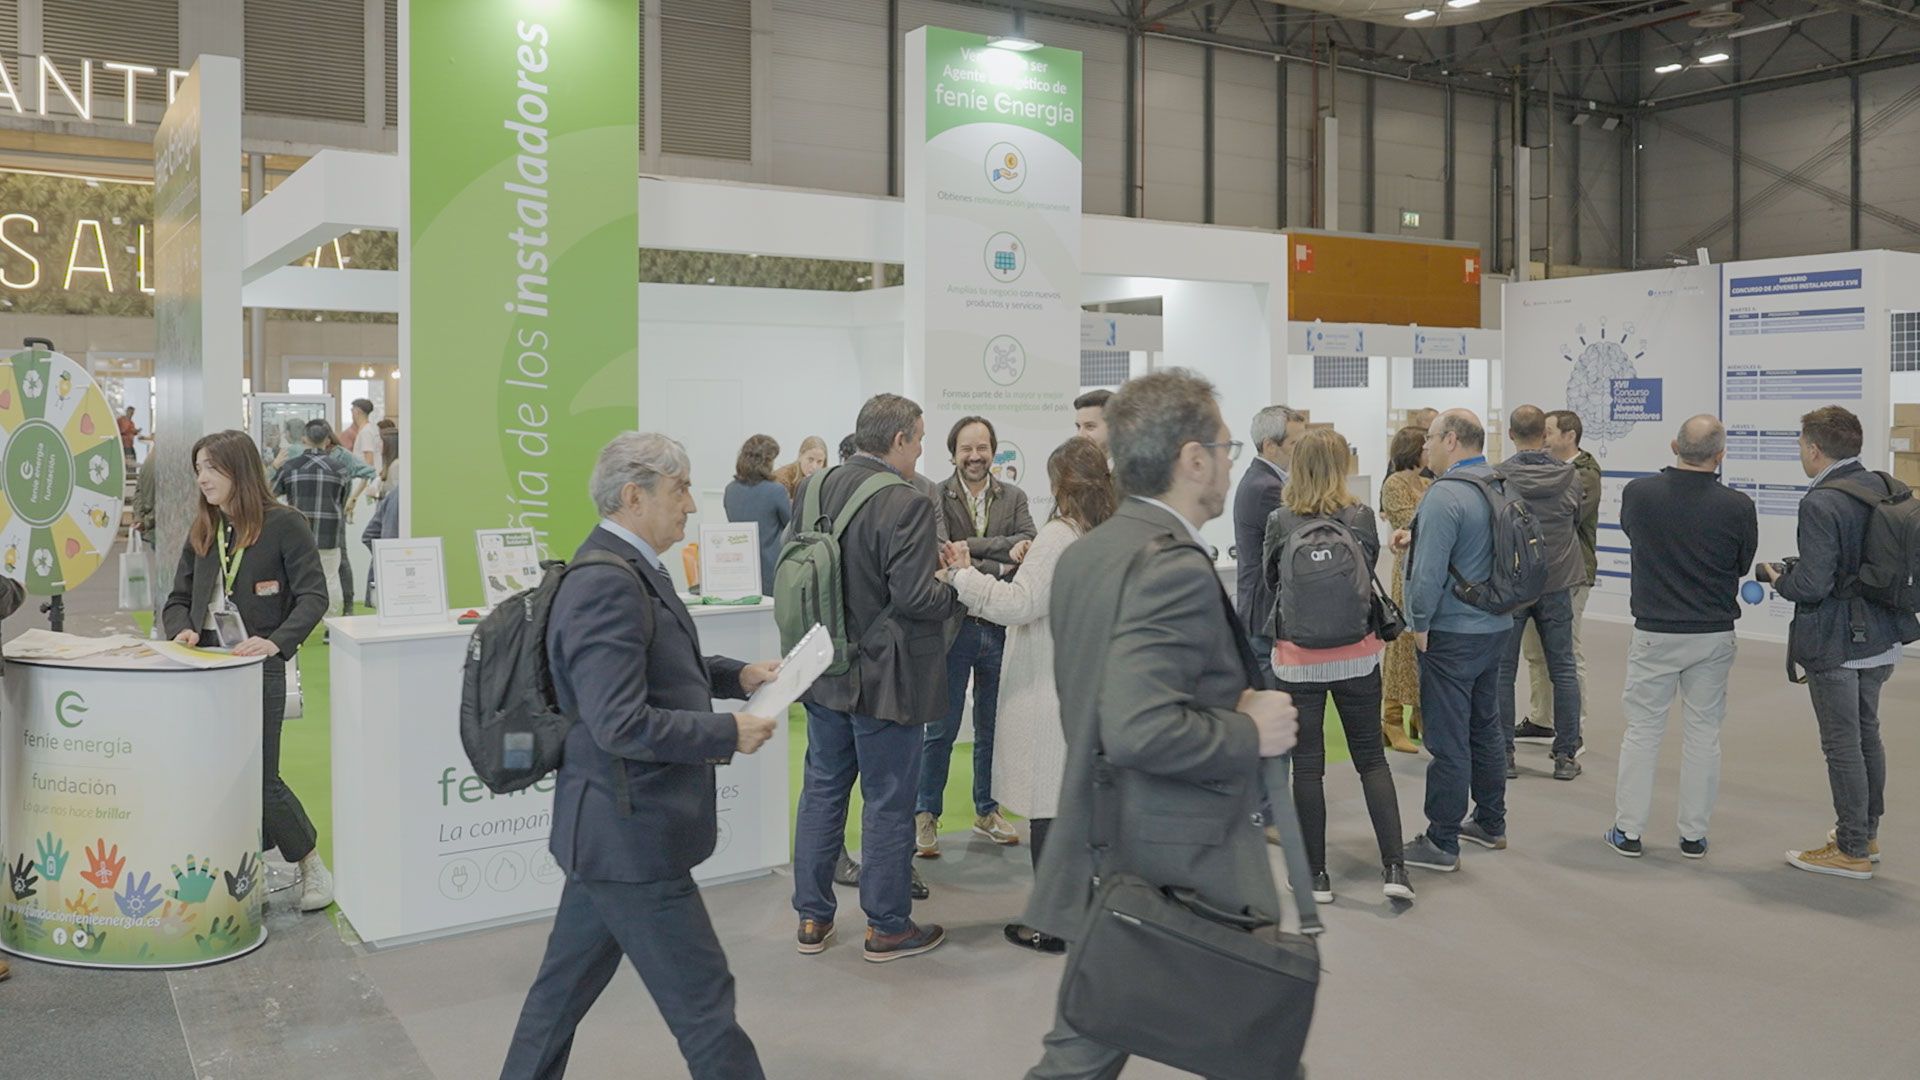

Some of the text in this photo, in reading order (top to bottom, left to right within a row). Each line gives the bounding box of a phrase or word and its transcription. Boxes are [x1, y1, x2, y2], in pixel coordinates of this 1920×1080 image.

[942, 64, 987, 82] Agente
[1052, 80, 1067, 95] de
[935, 83, 988, 111] feníe
[504, 19, 549, 317] instaladores
[505, 328, 549, 390] los
[505, 402, 549, 457] de
[63, 735, 133, 758] energía
[32, 772, 117, 797] fundación
[95, 807, 132, 820] brillar
[438, 808, 550, 842] La compañ
